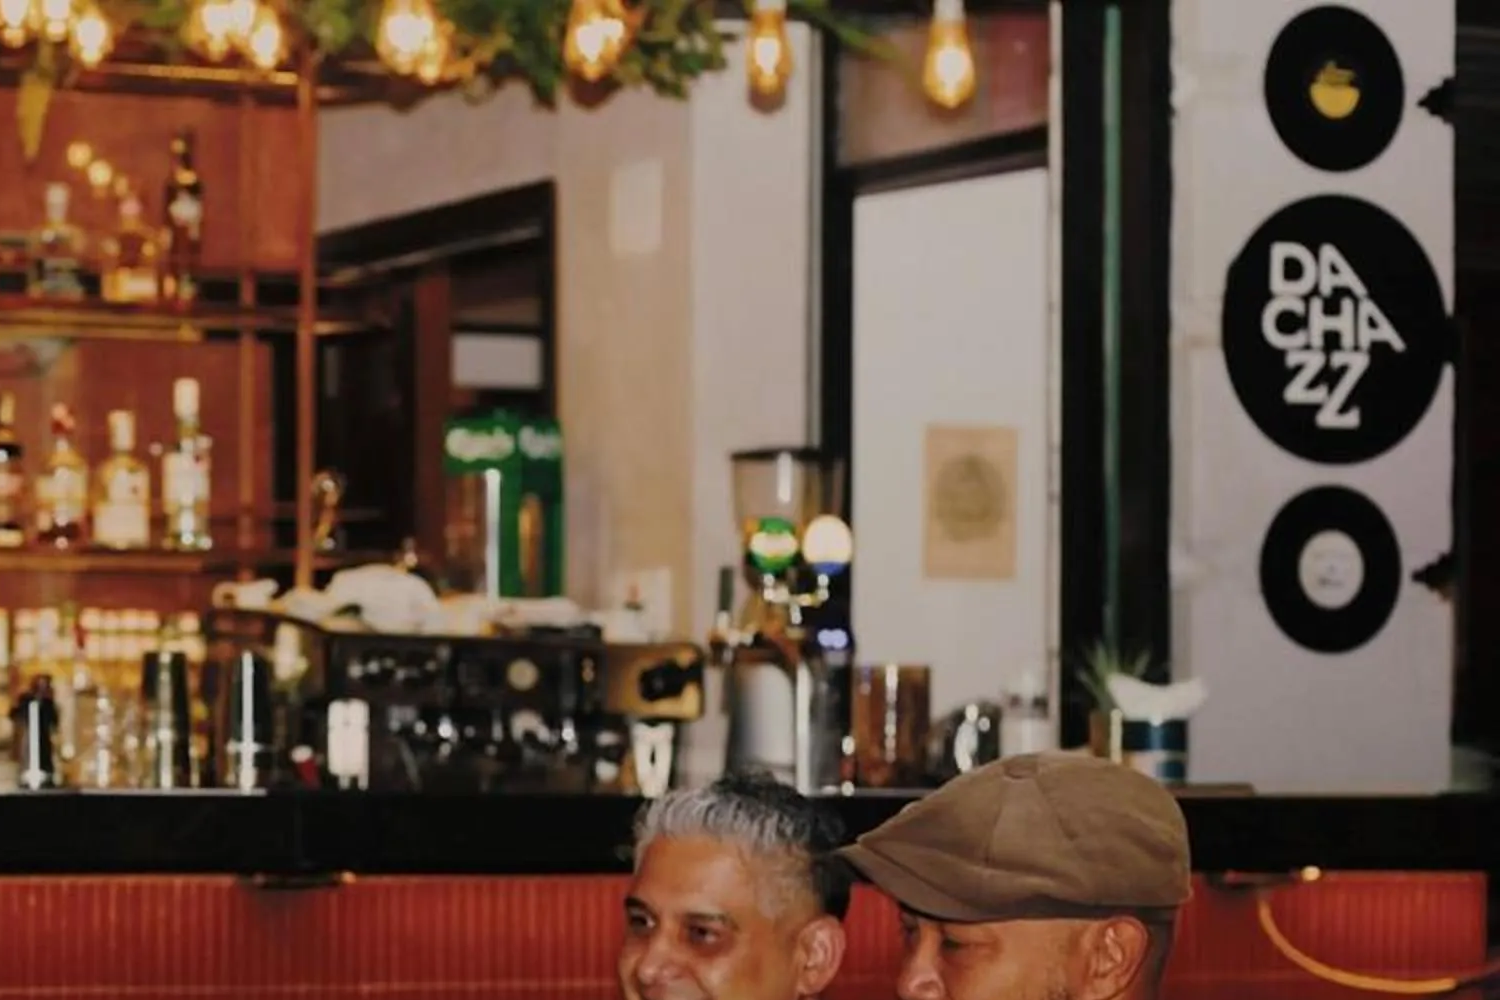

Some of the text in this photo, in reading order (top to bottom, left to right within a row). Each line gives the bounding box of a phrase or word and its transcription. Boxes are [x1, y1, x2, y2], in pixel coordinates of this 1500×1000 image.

[1269, 241, 1368, 297] DA
[1261, 296, 1407, 352] CHA
[1283, 351, 1370, 429] ZZ
